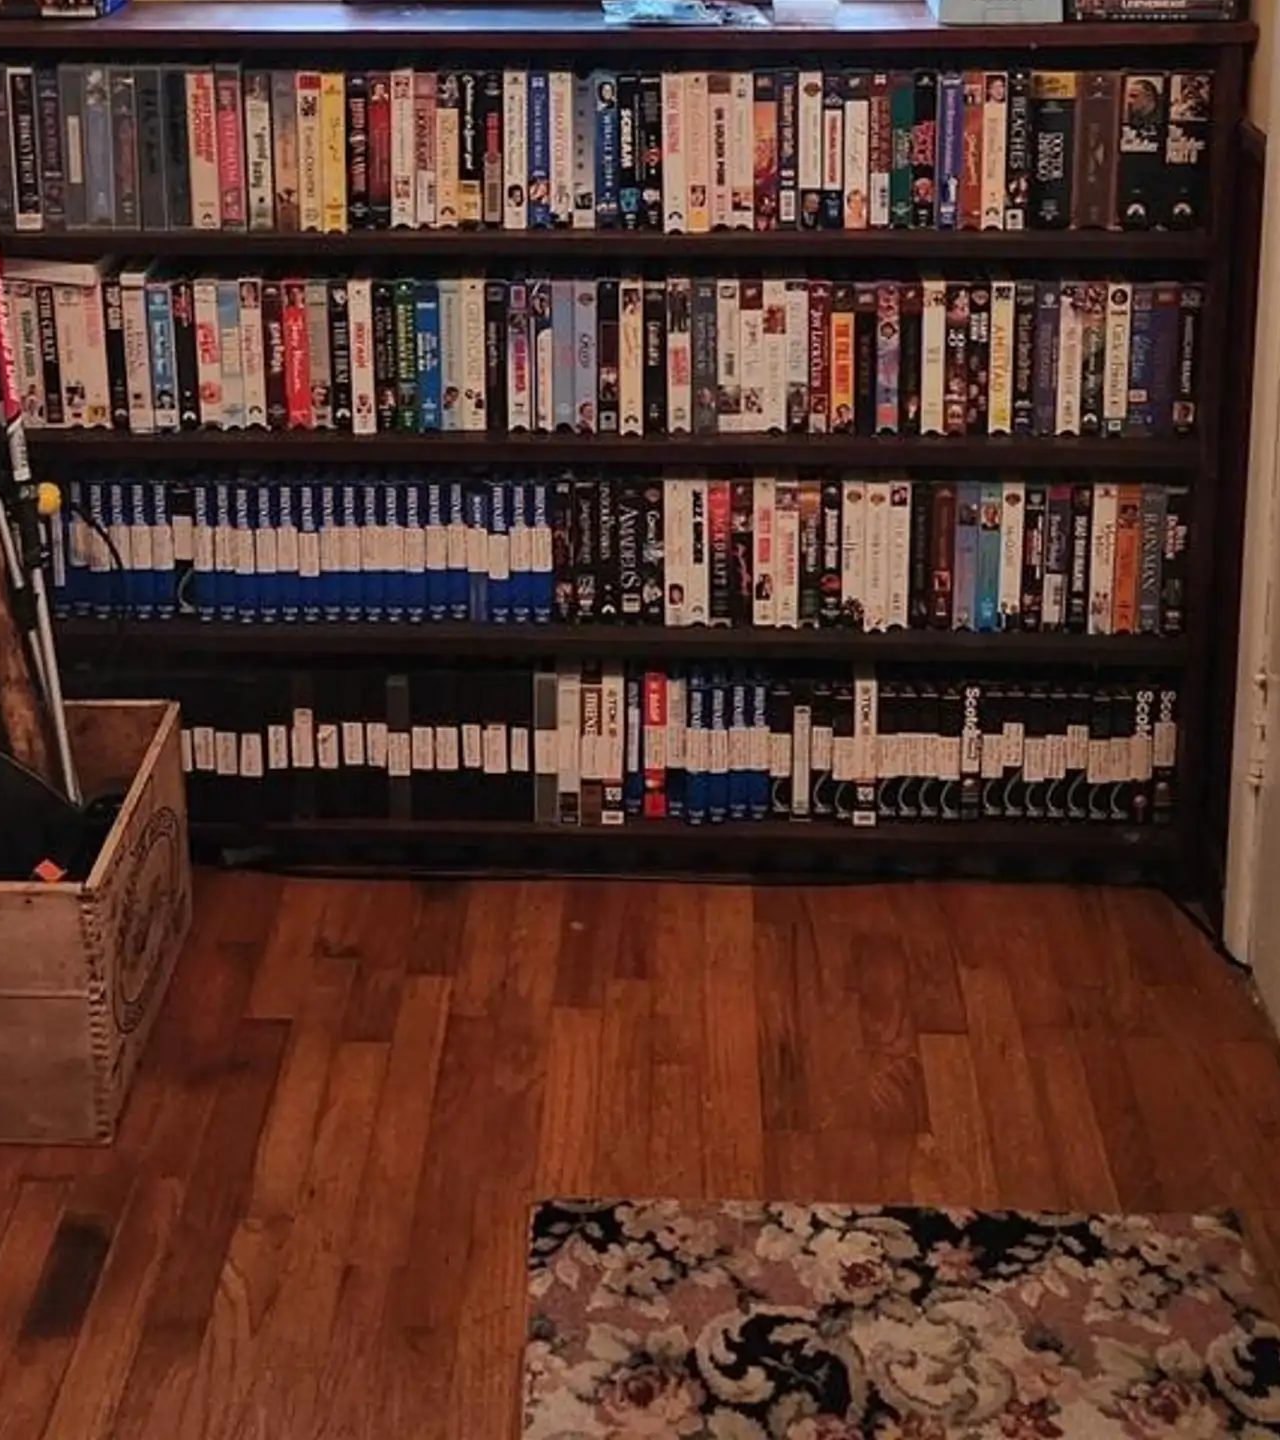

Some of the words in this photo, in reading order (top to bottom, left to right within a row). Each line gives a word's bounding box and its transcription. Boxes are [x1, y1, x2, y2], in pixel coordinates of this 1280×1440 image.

[714, 107, 726, 120] ON
[1010, 96, 1026, 170] BEACHES
[620, 108, 633, 168] SCREAM
[714, 123, 726, 159] GOLDEN
[1037, 131, 1050, 182] ZHIVAGO
[1051, 131, 1064, 179] DOCTOR
[714, 160, 726, 187] POND
[993, 325, 1005, 392] AMISTAD
[693, 489, 704, 519] JAZZ
[618, 503, 642, 589] AMADEUS
[713, 508, 726, 586] BACKDRAFT
[1143, 513, 1158, 549] RAIN
[1165, 515, 1179, 561] DURHAM
[1175, 526, 1188, 551] BULL
[1141, 548, 1157, 591] MAN
[608, 699, 618, 725] TDK
[650, 693, 660, 722] BASF
[861, 696, 871, 725] TDK
